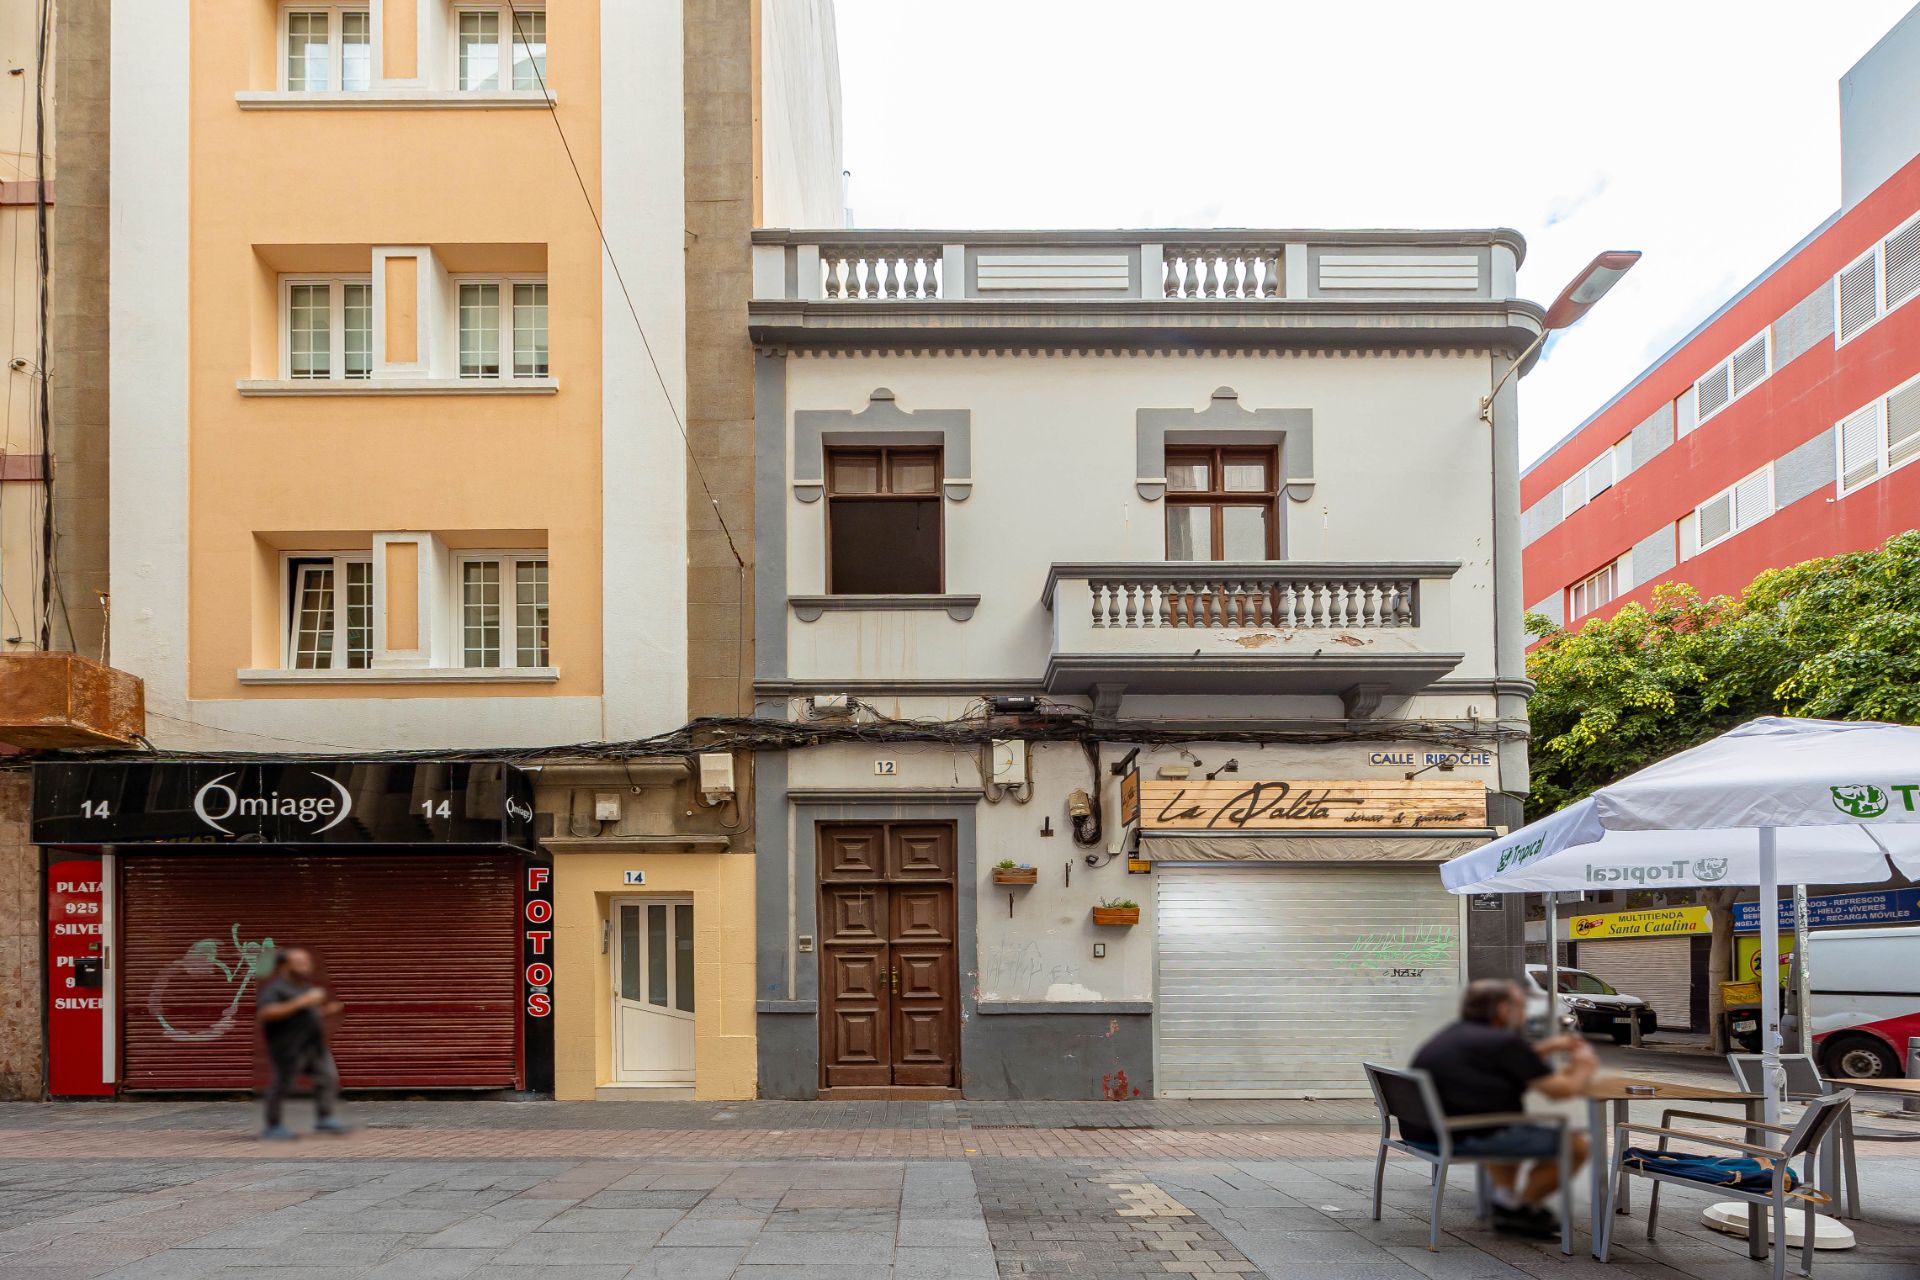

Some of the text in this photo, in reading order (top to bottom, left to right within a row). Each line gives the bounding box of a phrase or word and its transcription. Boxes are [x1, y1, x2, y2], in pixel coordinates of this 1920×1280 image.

[1371, 753, 1490, 765] CALLE RIPOCHE
[877, 761, 894, 773] 12
[194, 775, 345, 830] Omiage
[1157, 788, 1207, 822] La
[1207, 781, 1364, 828] Paleta
[80, 800, 110, 819] 14
[421, 799, 451, 819] 14
[1510, 831, 1548, 865] Tropical
[626, 871, 643, 883] 14
[1833, 896, 1886, 906] REFRESCOS
[65, 902, 99, 914] 925
[1817, 906, 1842, 915] HIELO
[1618, 911, 1684, 923] MULTITIENDA
[1826, 913, 1868, 922] RECARGA
[1869, 910, 1910, 920] MÓVILES
[1608, 923, 1640, 935] Santa
[1644, 920, 1697, 934] Catalina
[525, 867, 553, 1018] FOTOS
